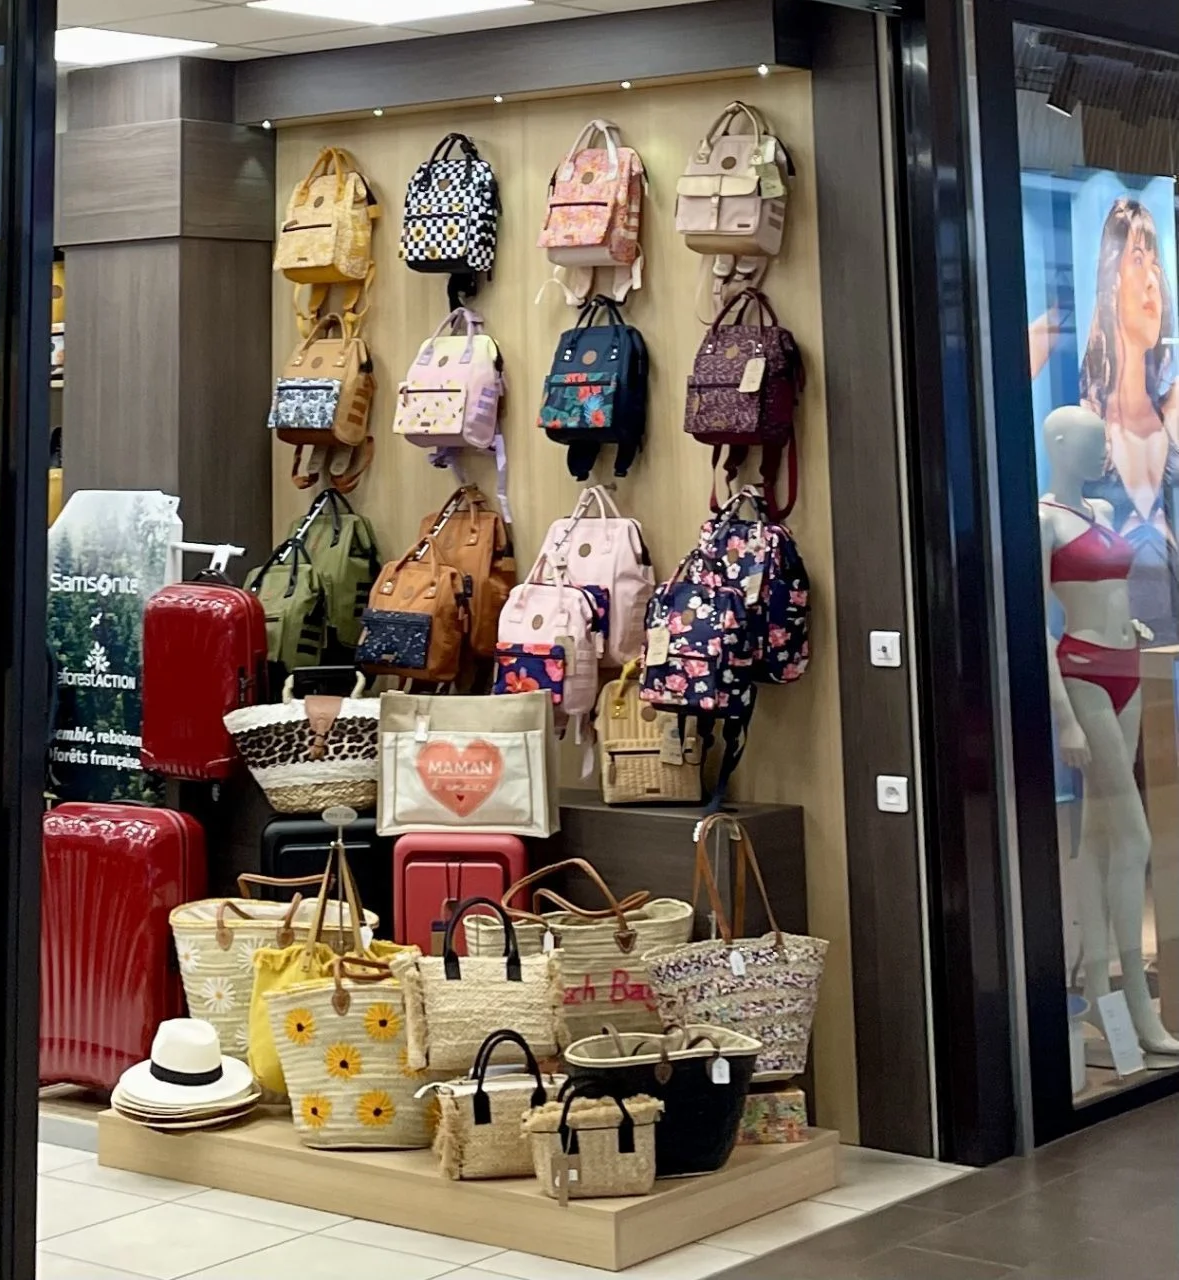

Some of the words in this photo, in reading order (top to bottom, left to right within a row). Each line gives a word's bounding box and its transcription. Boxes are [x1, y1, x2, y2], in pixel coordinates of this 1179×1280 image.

[49, 573, 139, 597] Samsonite
[53, 746, 89, 765] forêts
[427, 760, 493, 775] MAMAN
